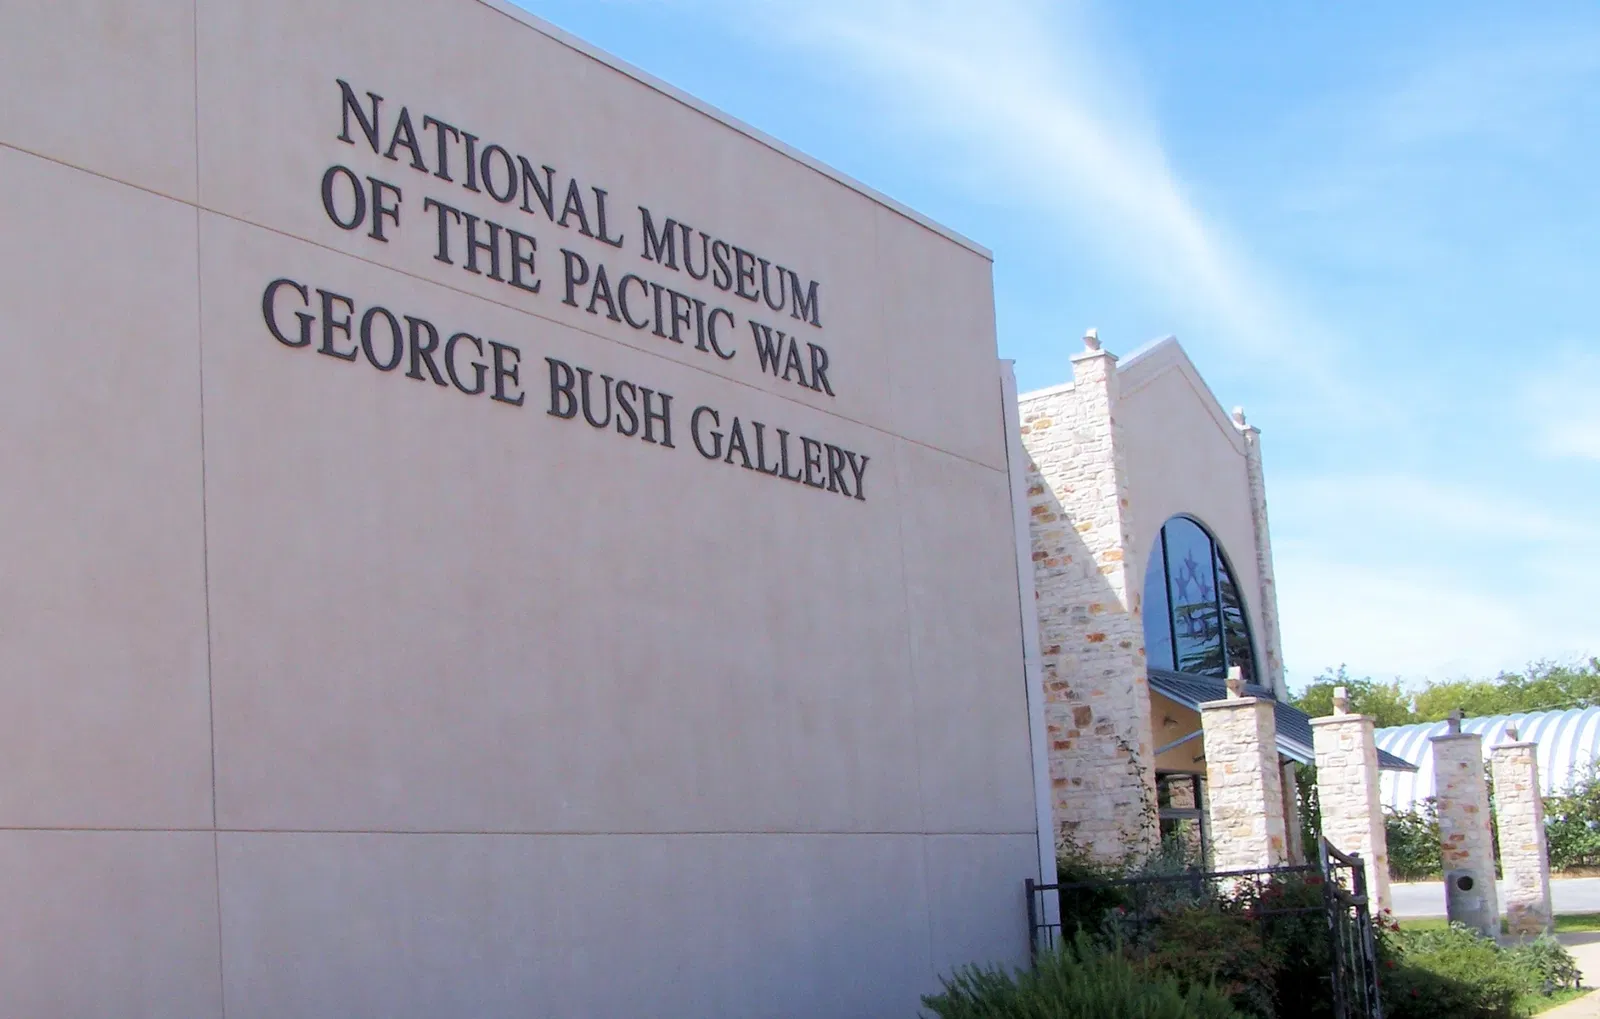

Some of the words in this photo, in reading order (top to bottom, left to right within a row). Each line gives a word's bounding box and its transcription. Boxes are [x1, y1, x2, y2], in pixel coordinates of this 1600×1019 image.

[321, 165, 402, 243] OF
[423, 197, 541, 294] THE
[560, 248, 736, 360] PACIFIC
[748, 320, 835, 397] WAR
[336, 79, 624, 248] NATIONAL
[638, 206, 822, 328] MUSEUM
[262, 278, 525, 407] GEORGE
[545, 357, 676, 449] BUSH
[691, 406, 871, 501] GALLERY
